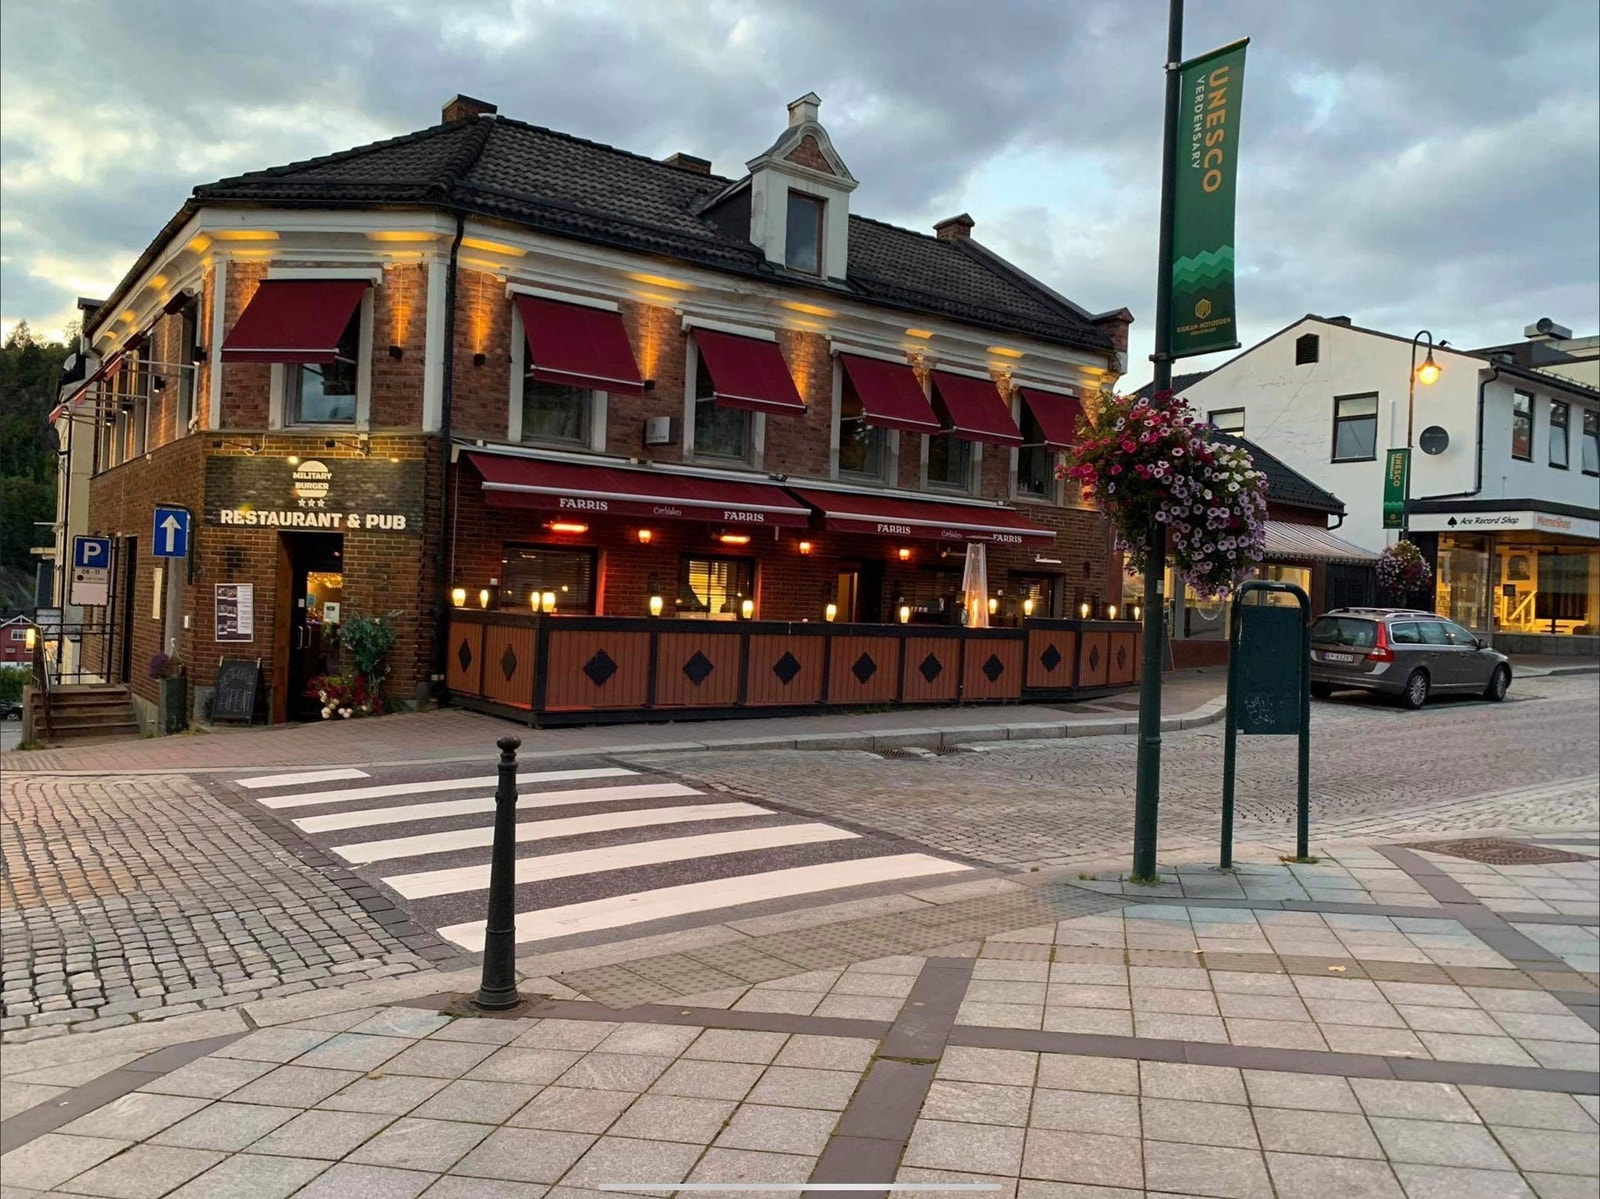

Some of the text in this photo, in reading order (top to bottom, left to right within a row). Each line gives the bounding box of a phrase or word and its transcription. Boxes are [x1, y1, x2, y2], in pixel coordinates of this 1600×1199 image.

[1191, 75, 1206, 170] VERDENSARV
[1202, 65, 1230, 193] UNESCO
[293, 471, 332, 480] MILITARY
[1393, 453, 1403, 487] UNESCO
[295, 482, 329, 490] BURGER
[559, 498, 608, 511] FARRIS
[220, 509, 406, 530] RESTAURANT & PUB
[724, 511, 764, 522] FARRIS
[1460, 516, 1520, 526] Ace Record Shop
[877, 524, 911, 535] FARRIS
[993, 534, 1023, 544] FARRIS
[83, 541, 102, 565] P
